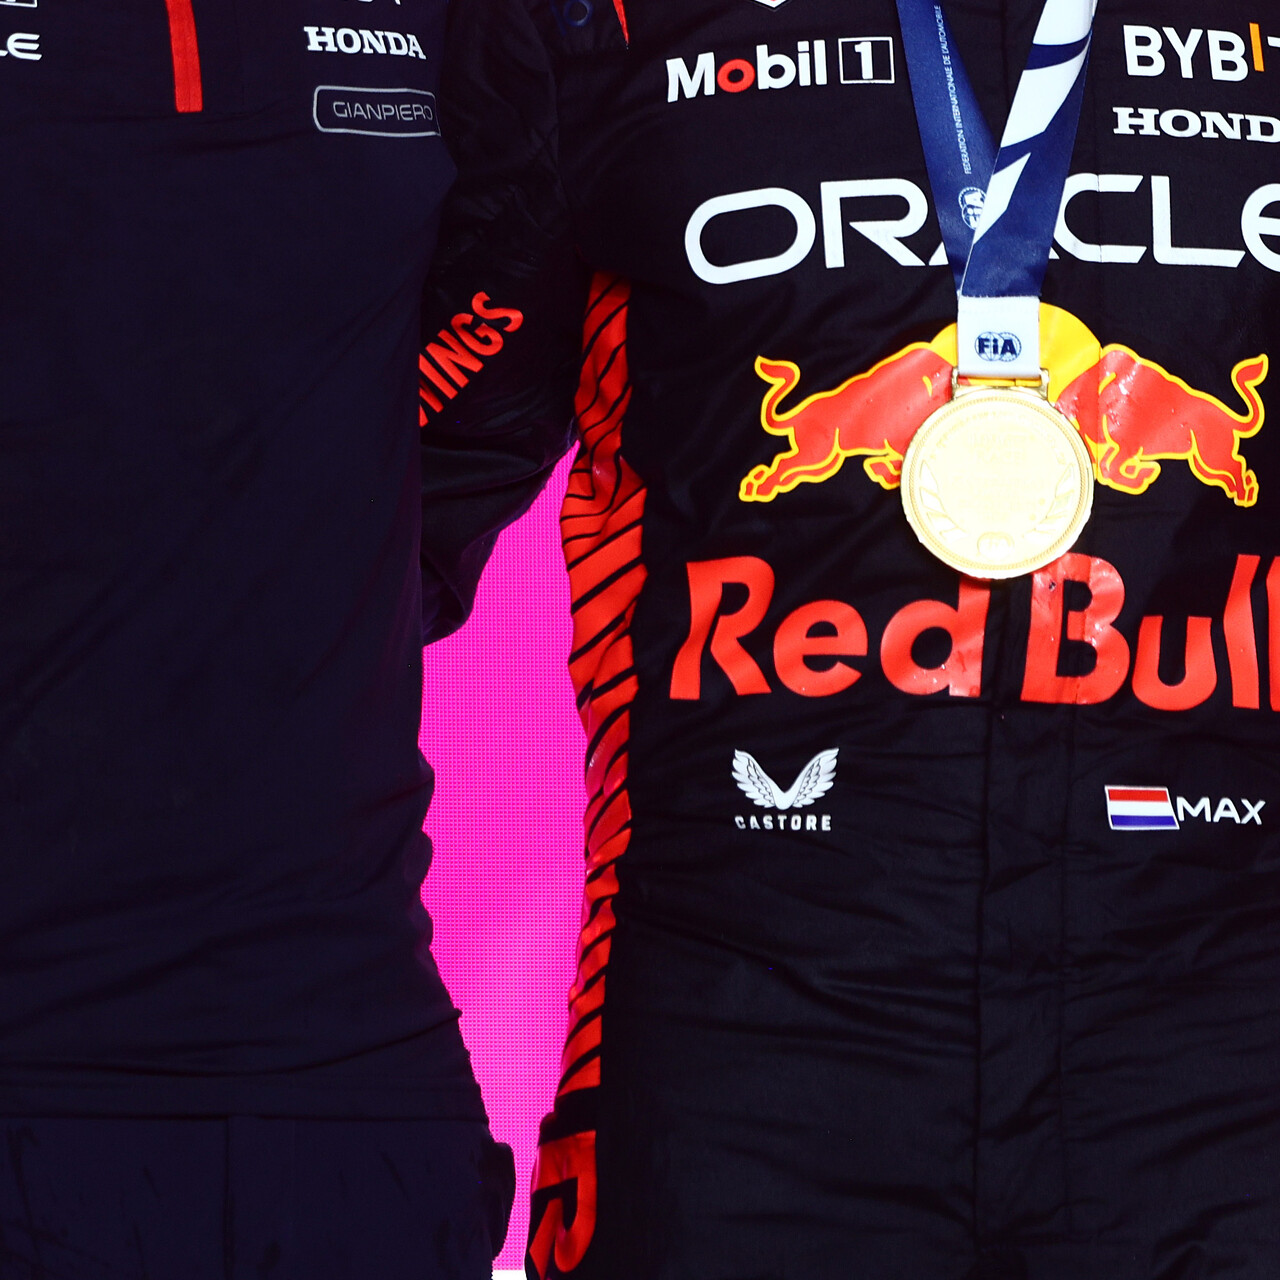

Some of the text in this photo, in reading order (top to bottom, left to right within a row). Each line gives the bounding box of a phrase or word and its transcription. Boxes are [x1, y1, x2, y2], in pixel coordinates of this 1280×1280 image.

[303, 25, 427, 60] HONDA
[666, 39, 828, 103] Mobil
[332, 99, 433, 122] GIANPIERO
[670, 556, 989, 701] Red
[735, 812, 833, 831] CASTORE
[1177, 794, 1265, 827] MAX
